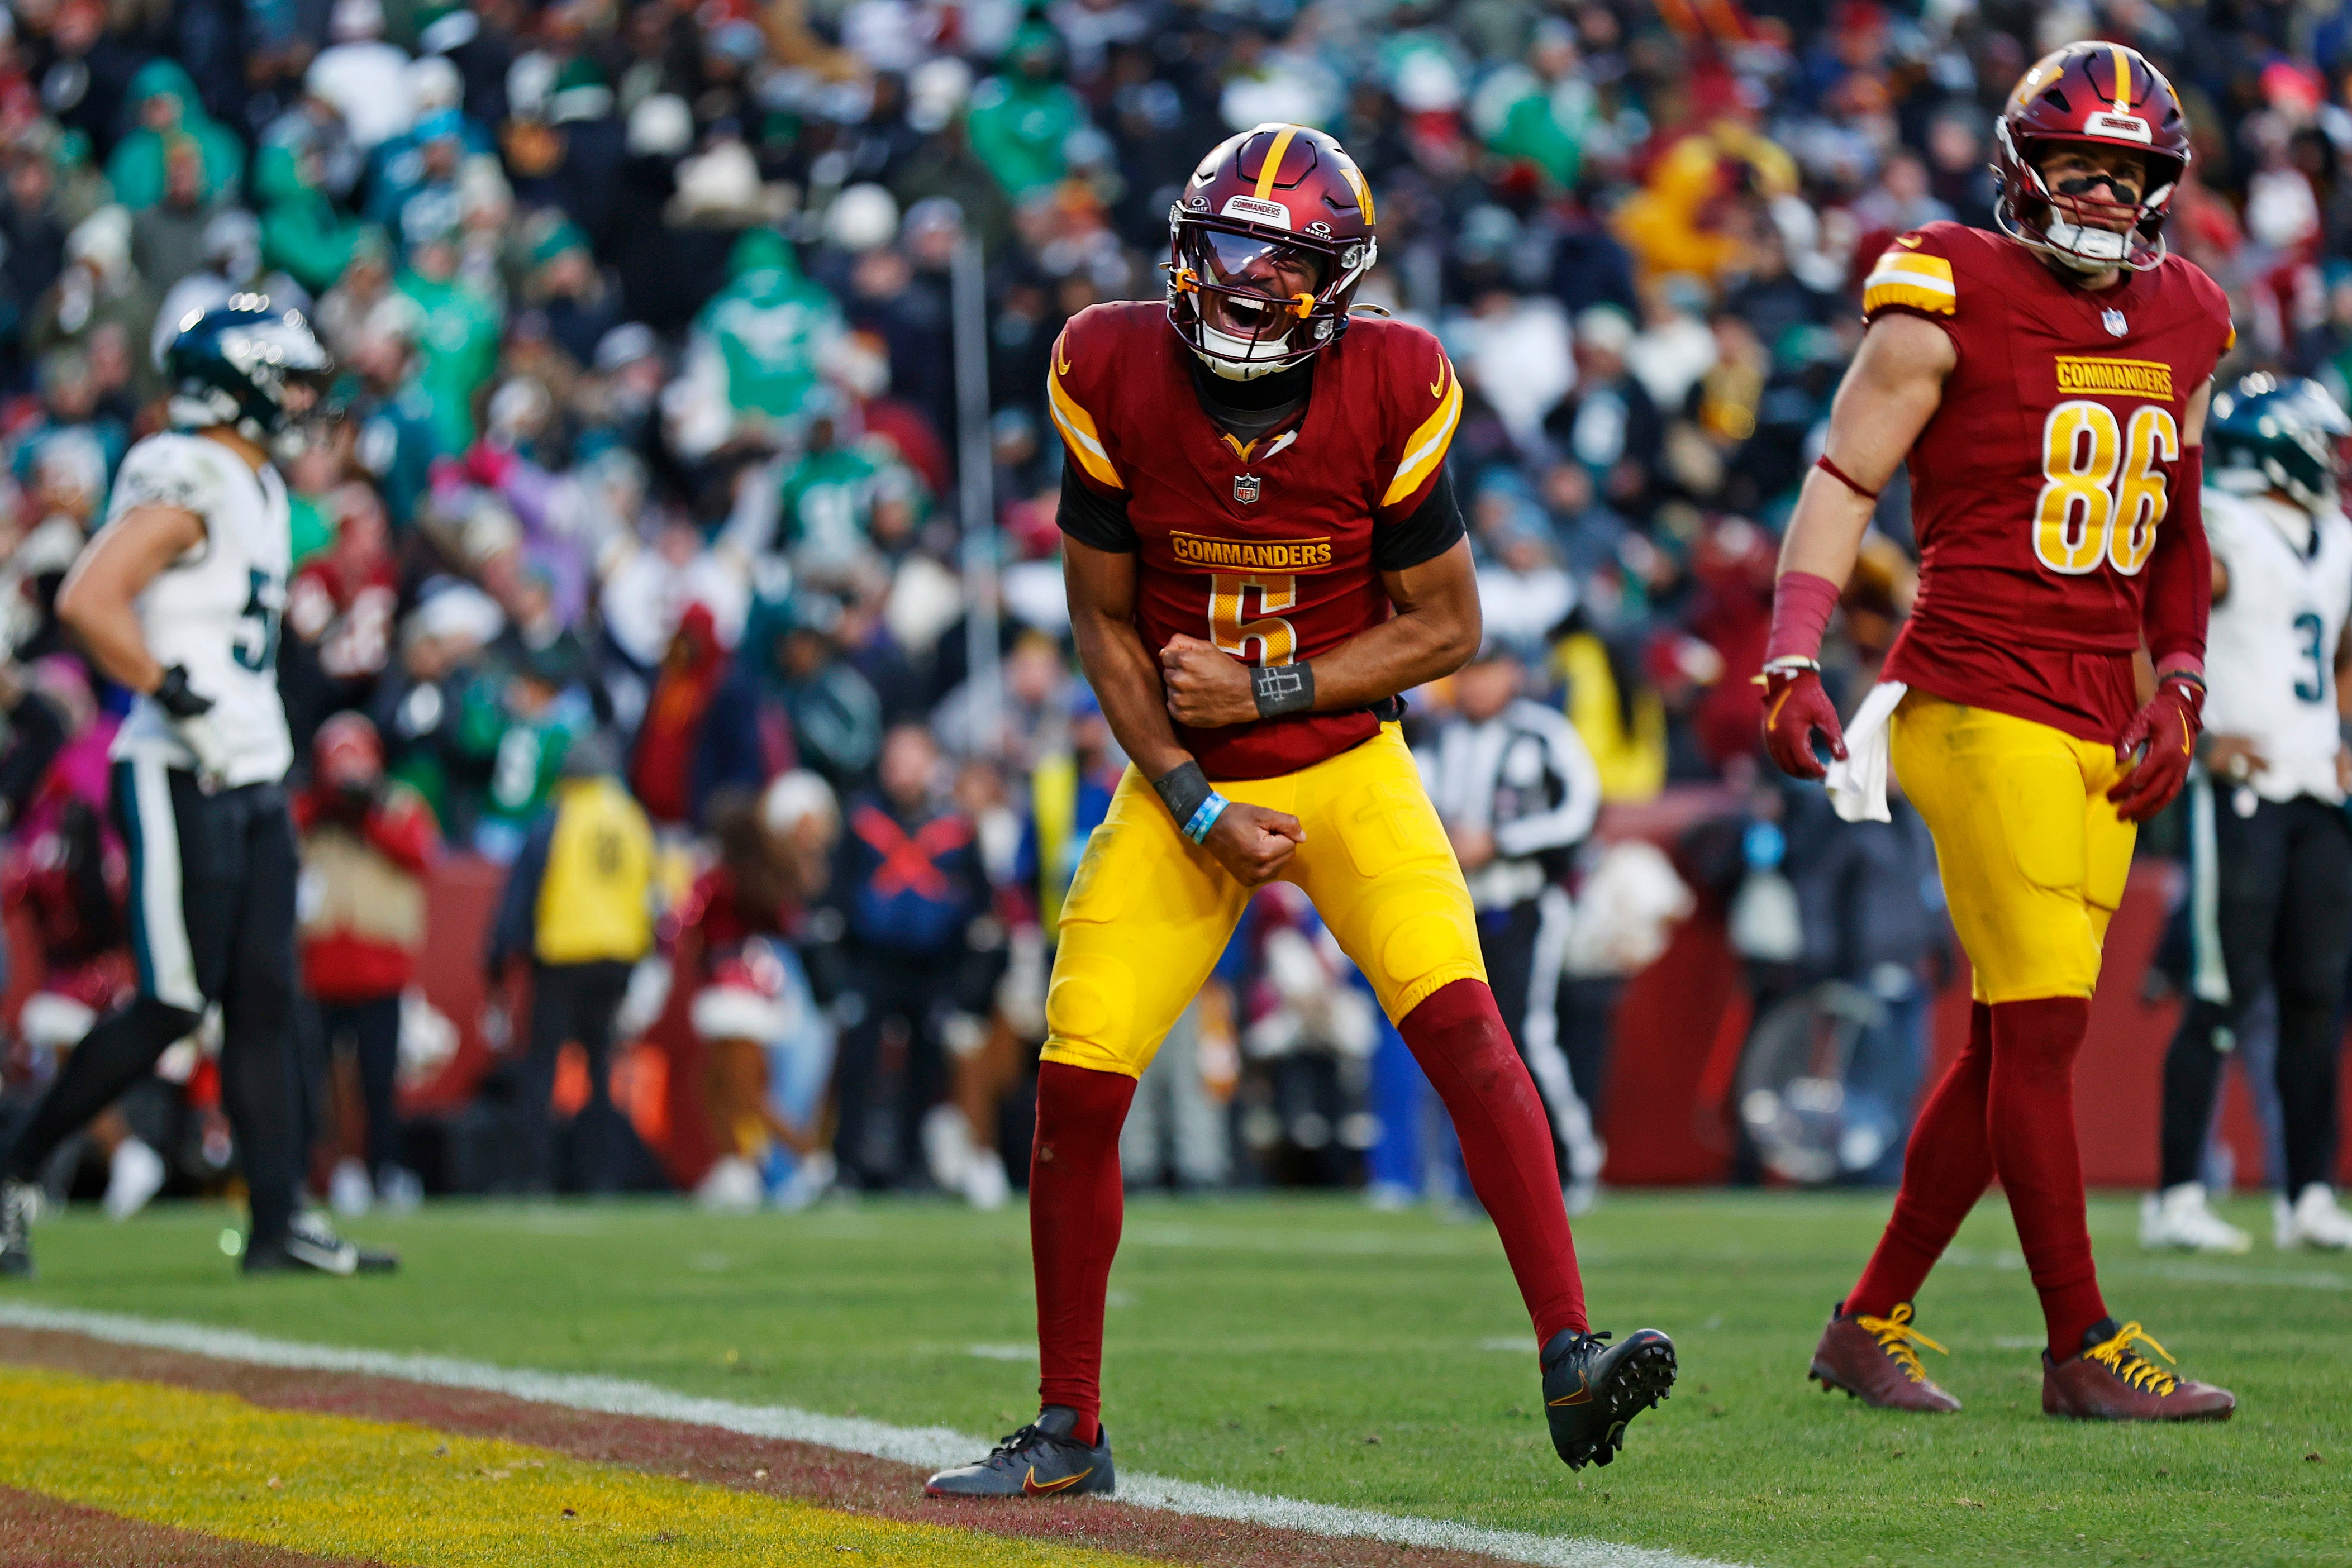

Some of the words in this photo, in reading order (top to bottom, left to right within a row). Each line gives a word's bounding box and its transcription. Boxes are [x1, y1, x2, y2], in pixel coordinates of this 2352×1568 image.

[1232, 200, 1280, 216] COMMANDERS
[1304, 227, 1333, 240] OAKLEY
[2056, 362, 2173, 394] COMMANDERS
[1239, 489, 1255, 499] NFL
[2032, 400, 2178, 575] 86
[1173, 537, 1332, 566] COMMANDERS
